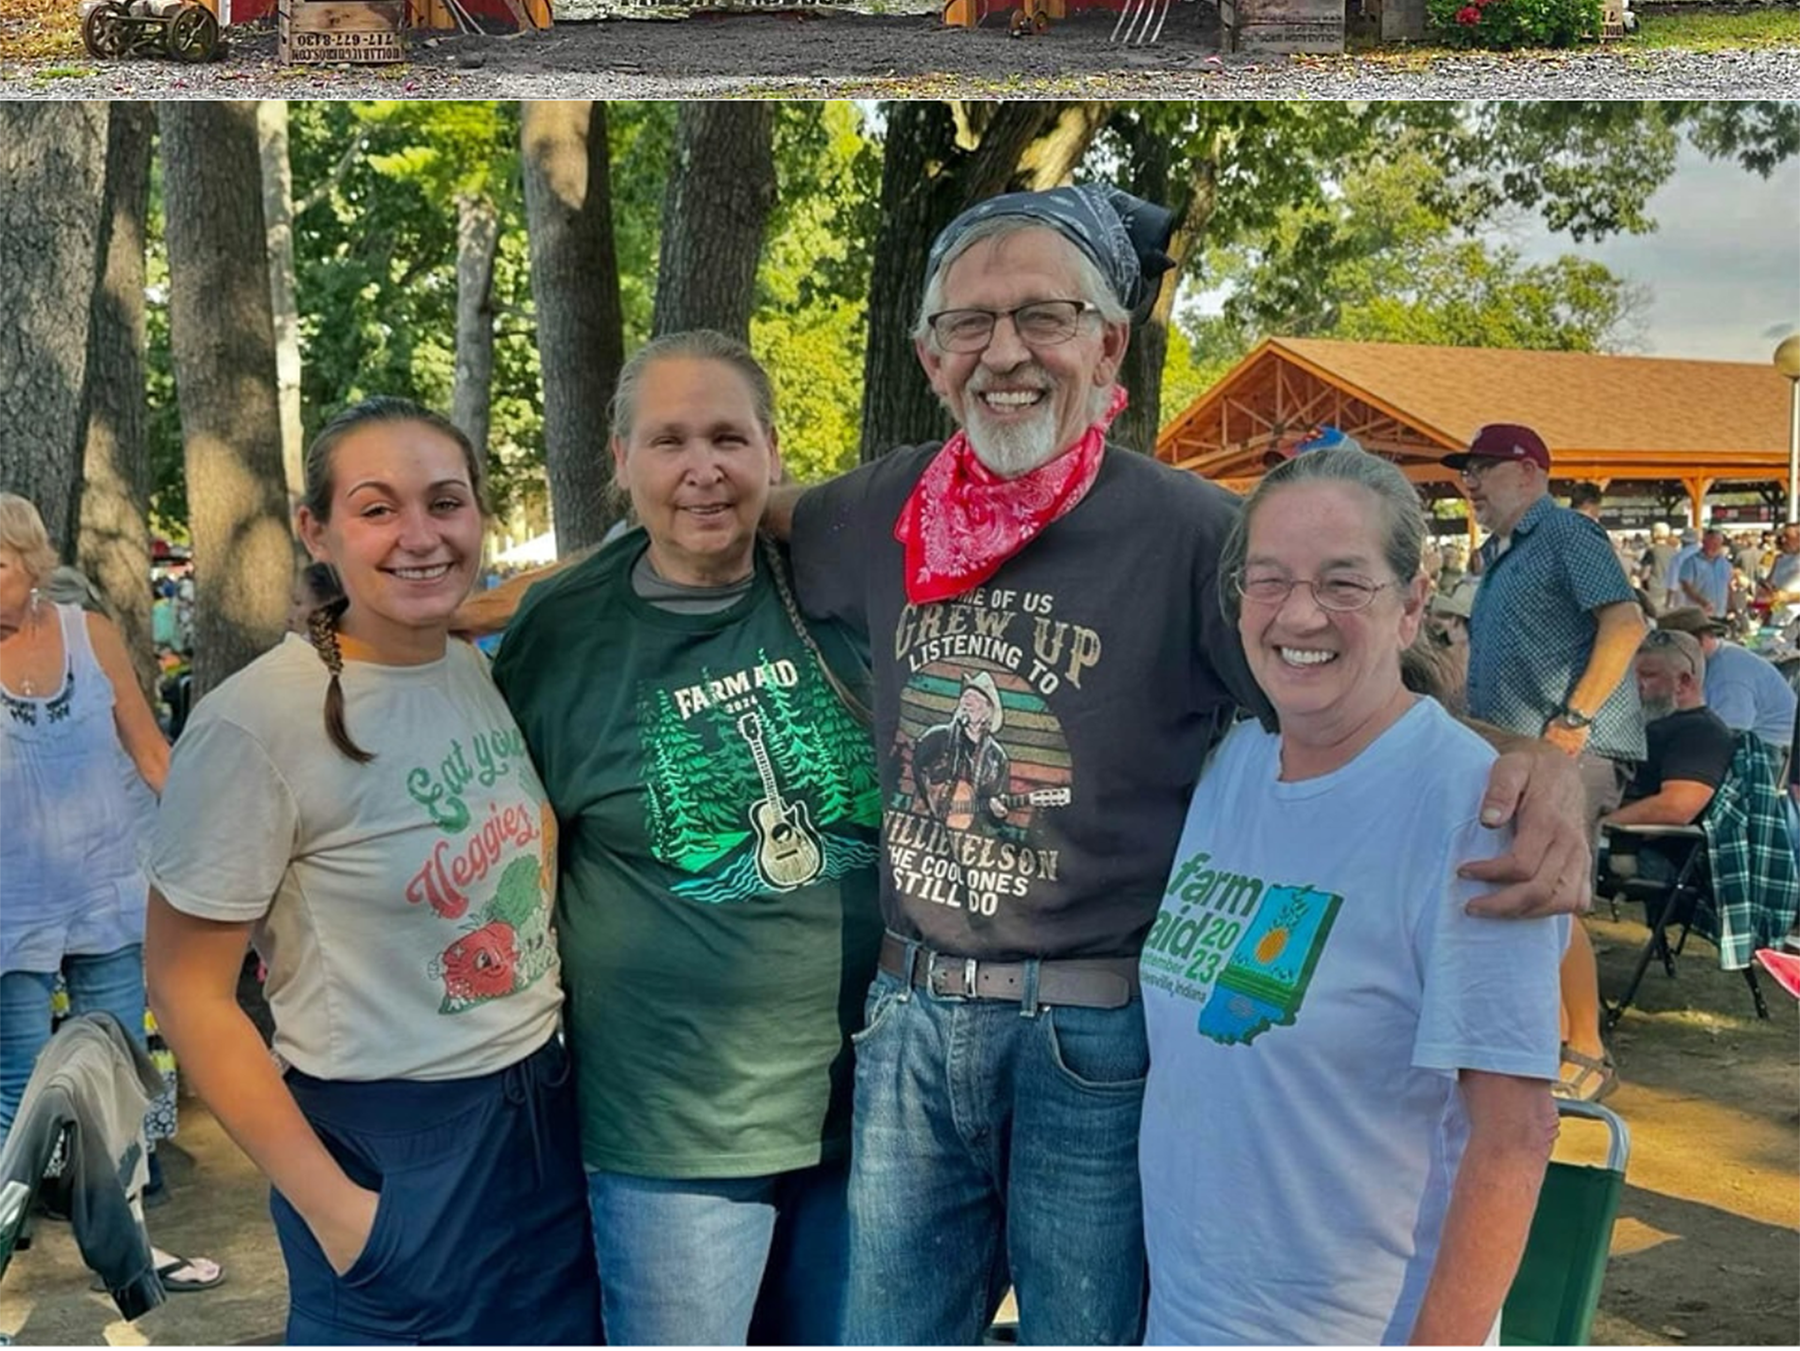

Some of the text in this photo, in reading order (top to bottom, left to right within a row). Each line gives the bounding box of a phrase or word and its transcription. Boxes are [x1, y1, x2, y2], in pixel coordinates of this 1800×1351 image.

[991, 589, 1017, 609] OF
[1022, 592, 1054, 615] US
[895, 603, 1101, 690] GREW UP
[909, 634, 1059, 695] LISTENING TO
[674, 670, 752, 721] FARM
[406, 727, 526, 835] Eat you
[404, 802, 540, 920] Veggies
[888, 845, 918, 869] HE
[967, 869, 1030, 898] ONES
[1167, 852, 1263, 918] farm
[892, 866, 999, 917] STILL DO
[1202, 917, 1240, 951] 20
[1185, 948, 1223, 984] 23
